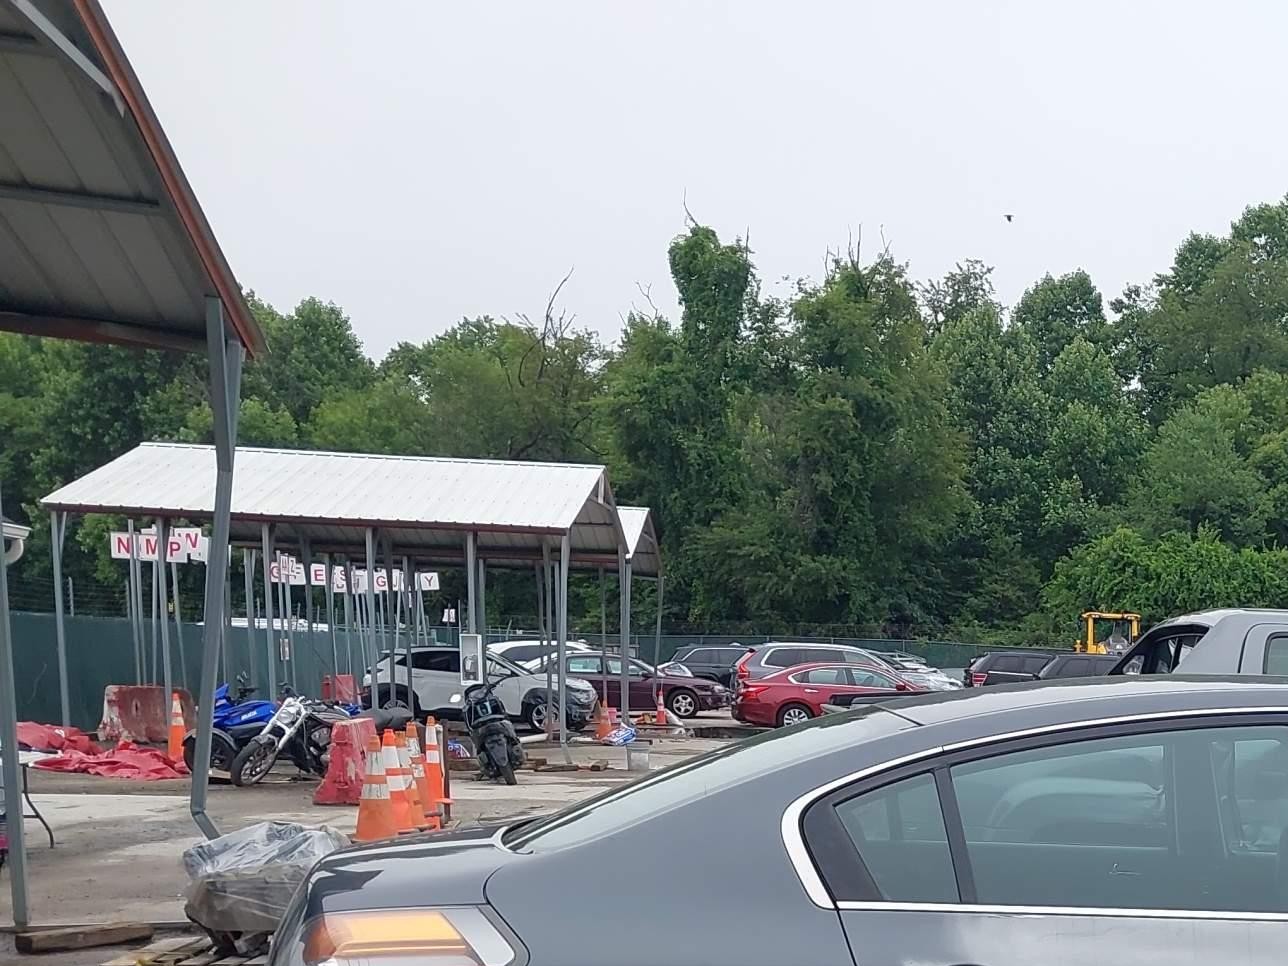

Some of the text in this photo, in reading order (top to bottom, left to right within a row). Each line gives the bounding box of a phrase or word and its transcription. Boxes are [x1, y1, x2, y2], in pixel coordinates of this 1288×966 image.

[117, 536, 130, 553] N
[146, 538, 158, 555] M
[170, 541, 181, 557] P
[314, 569, 324, 581] E
[376, 575, 386, 587] G
[424, 575, 434, 587] Y
